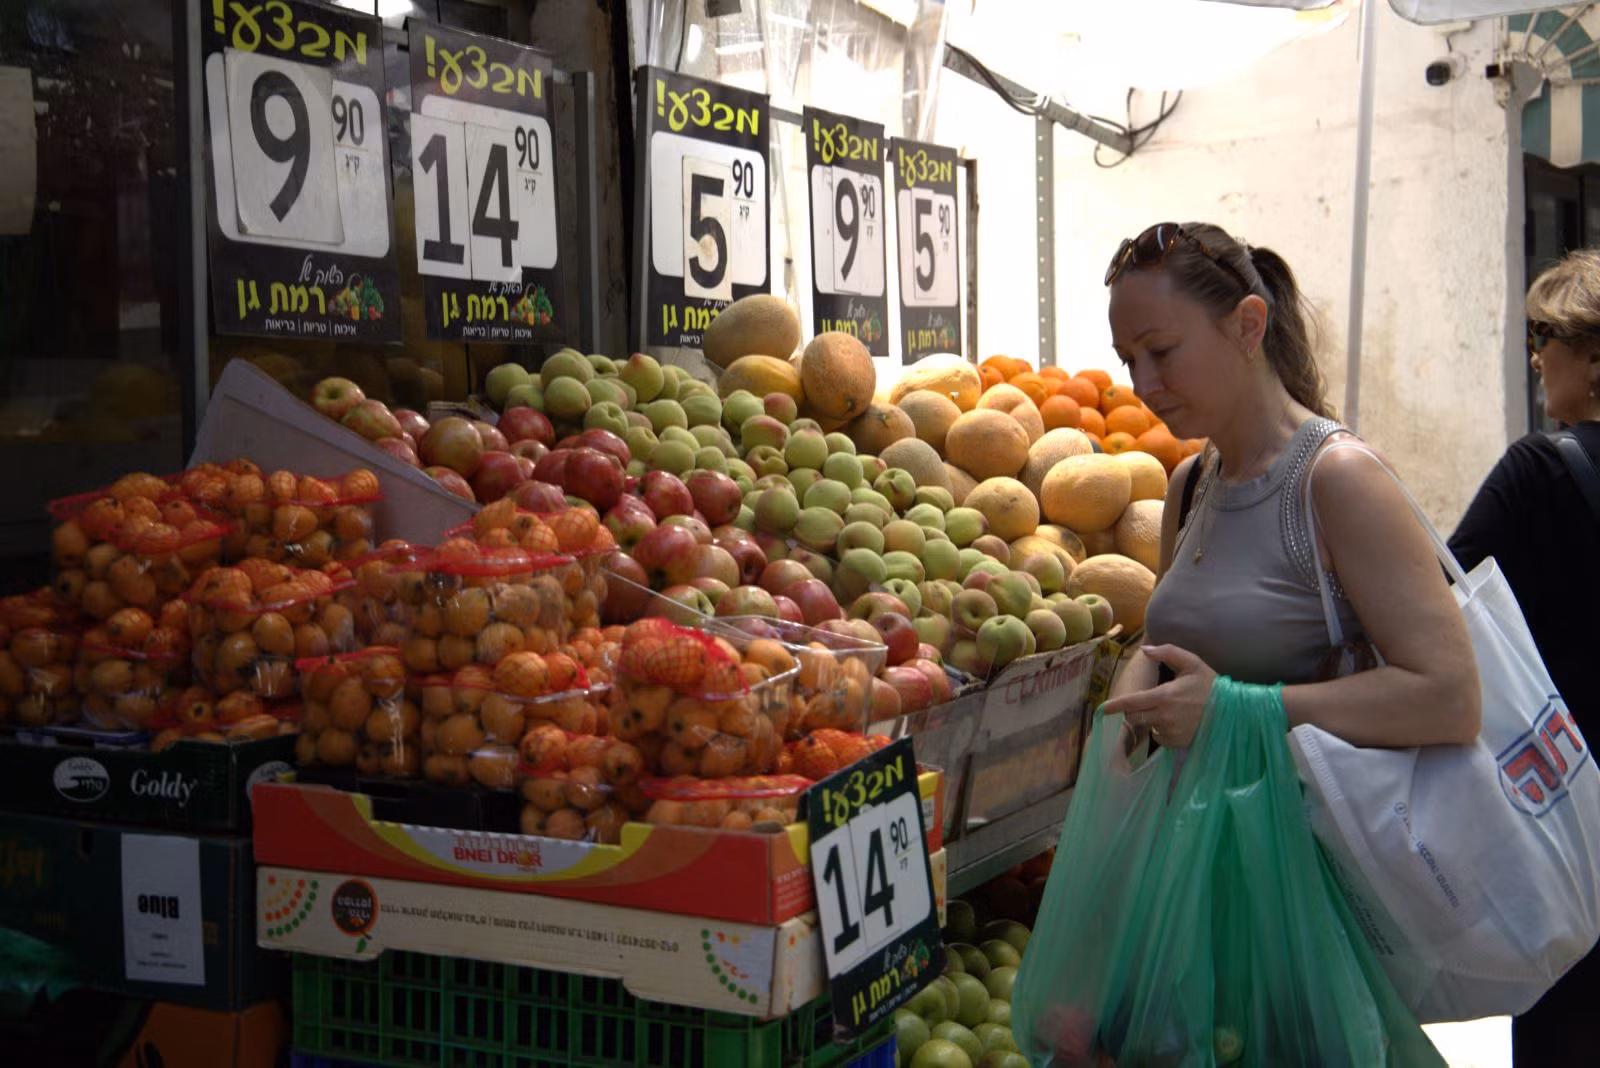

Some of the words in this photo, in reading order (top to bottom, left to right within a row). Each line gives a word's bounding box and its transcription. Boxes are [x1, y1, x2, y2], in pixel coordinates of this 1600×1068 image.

[212, 0, 367, 64] מבצע!
[425, 35, 543, 98] מבצע!
[656, 79, 760, 136] מבצע!
[250, 70, 311, 222] 9
[331, 95, 364, 146] 90
[813, 119, 878, 164] מבצע!
[900, 147, 952, 188] מבצע!
[418, 133, 519, 268] 14
[515, 126, 540, 171] 90
[688, 173, 727, 289] 5
[732, 159, 754, 199] 90
[835, 178, 859, 283] 9
[862, 184, 876, 219] 90
[915, 198, 936, 292] 5
[939, 204, 951, 235] 90
[237, 278, 261, 320] גן
[269, 281, 326, 315] רמת
[442, 292, 460, 328] גן
[466, 293, 509, 323] רמת
[663, 303, 678, 336] גן
[130, 768, 196, 807] Goldy
[822, 756, 903, 828] מבצע!
[454, 847, 493, 863] BNEI
[138, 893, 180, 920] Blue
[823, 827, 895, 955] 14
[890, 816, 909, 855] 90
[851, 991, 867, 1025] גן
[869, 967, 900, 1009] רמת
